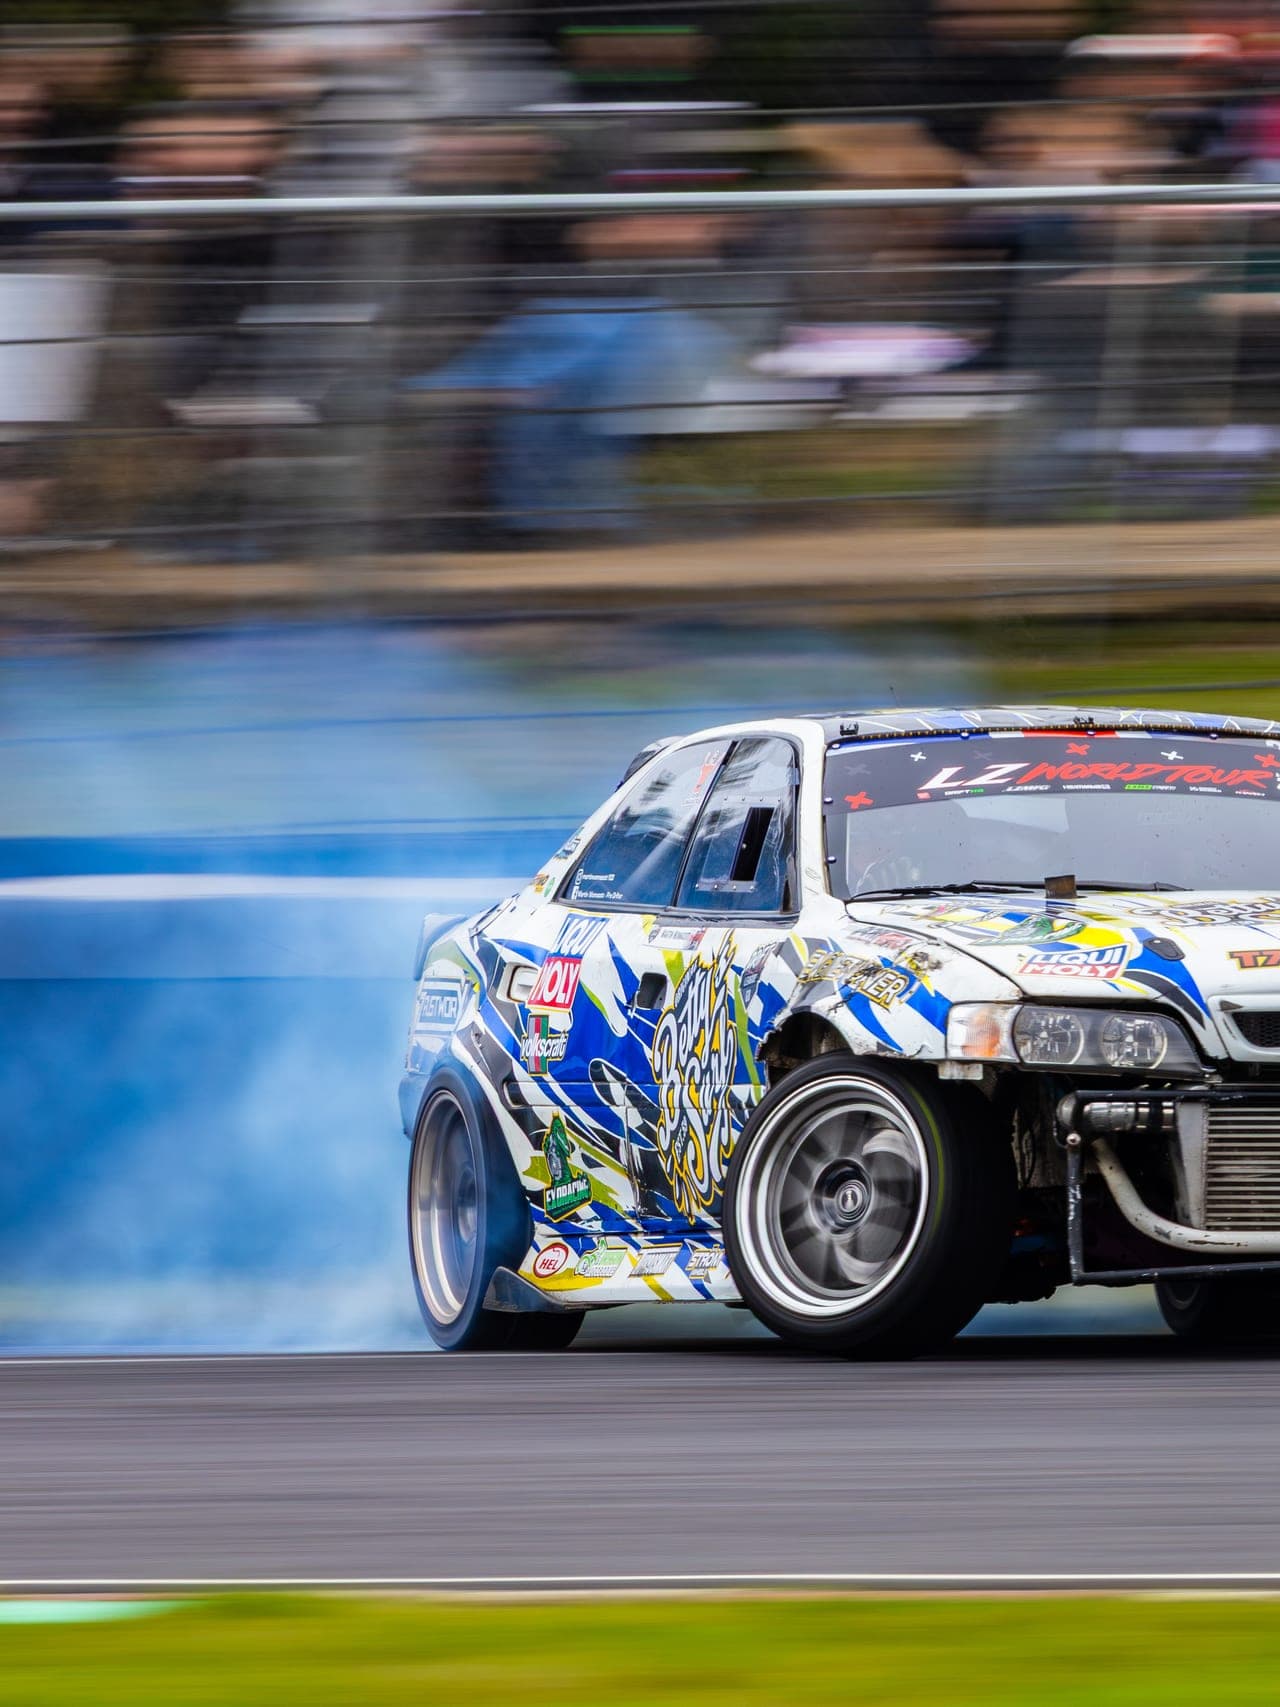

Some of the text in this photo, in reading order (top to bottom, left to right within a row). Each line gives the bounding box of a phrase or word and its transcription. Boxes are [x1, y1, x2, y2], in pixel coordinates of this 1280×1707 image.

[918, 762, 1030, 790] LZ
[1029, 947, 1124, 964] LIQUI
[1022, 964, 1119, 978] MOLY
[530, 963, 580, 1005] MOLY
[521, 1031, 568, 1057] volkscraft
[541, 1258, 558, 1270] HEL
